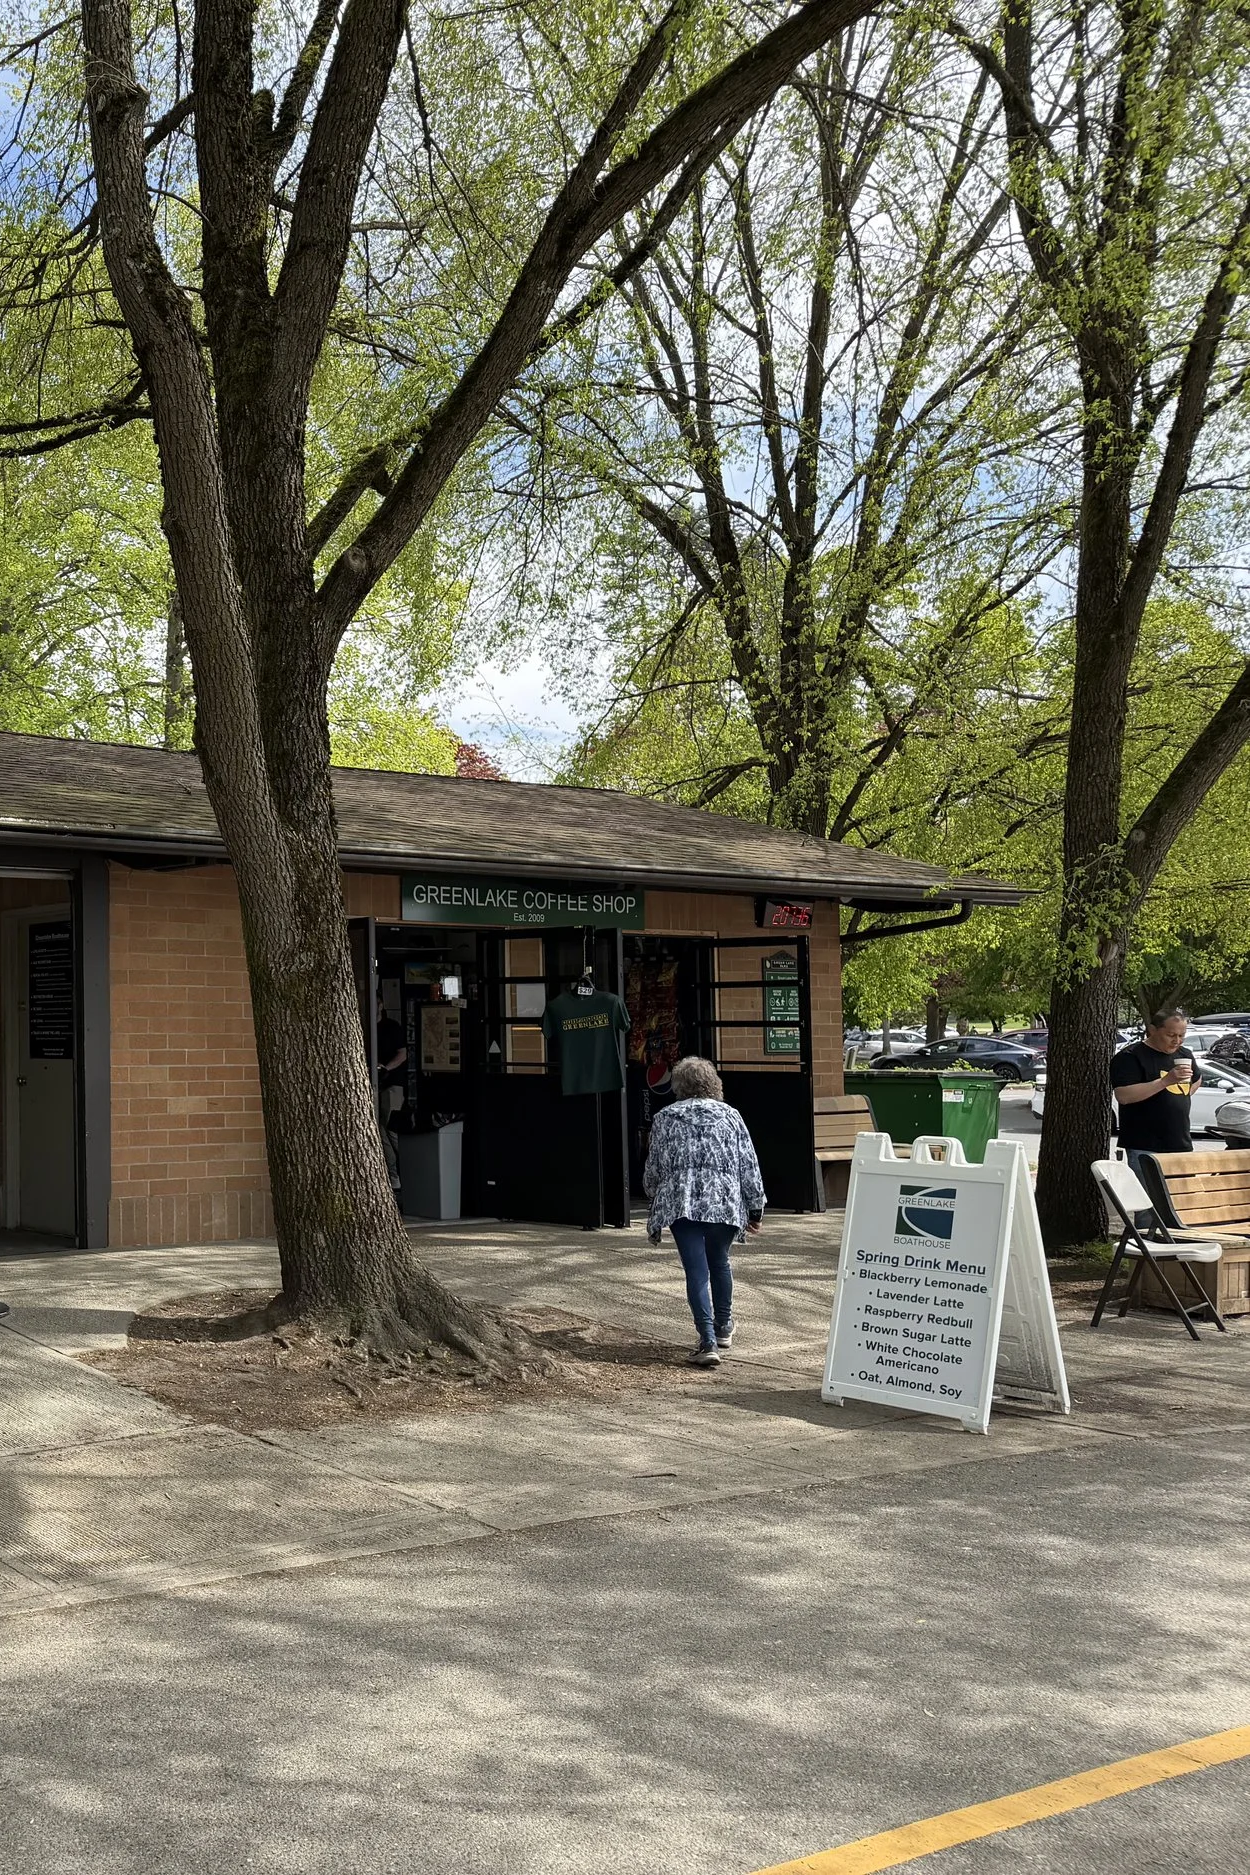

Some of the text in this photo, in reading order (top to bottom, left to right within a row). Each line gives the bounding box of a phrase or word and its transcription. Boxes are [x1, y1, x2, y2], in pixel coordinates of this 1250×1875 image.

[413, 884, 636, 914] GREENLAKE COFFEE SHOP
[513, 912, 545, 923] Est. 2009
[562, 1019, 609, 1031] GREENLAKE
[642, 1089, 651, 1121] pepsi
[898, 1197, 956, 1209] GREENLAKE
[893, 1236, 951, 1249] BOATHOUSE
[856, 1249, 986, 1275] Spring Drink Menu
[859, 1268, 987, 1294] Blackberry Lemonade
[876, 1288, 964, 1310] Lavender Latte
[864, 1305, 973, 1329] Raspberry Redbull
[861, 1322, 972, 1347] Brown Sugar Latte
[865, 1340, 963, 1365] White Chocolate
[875, 1355, 939, 1375] Americano
[858, 1370, 962, 1400] Oat, Almond, Soy
